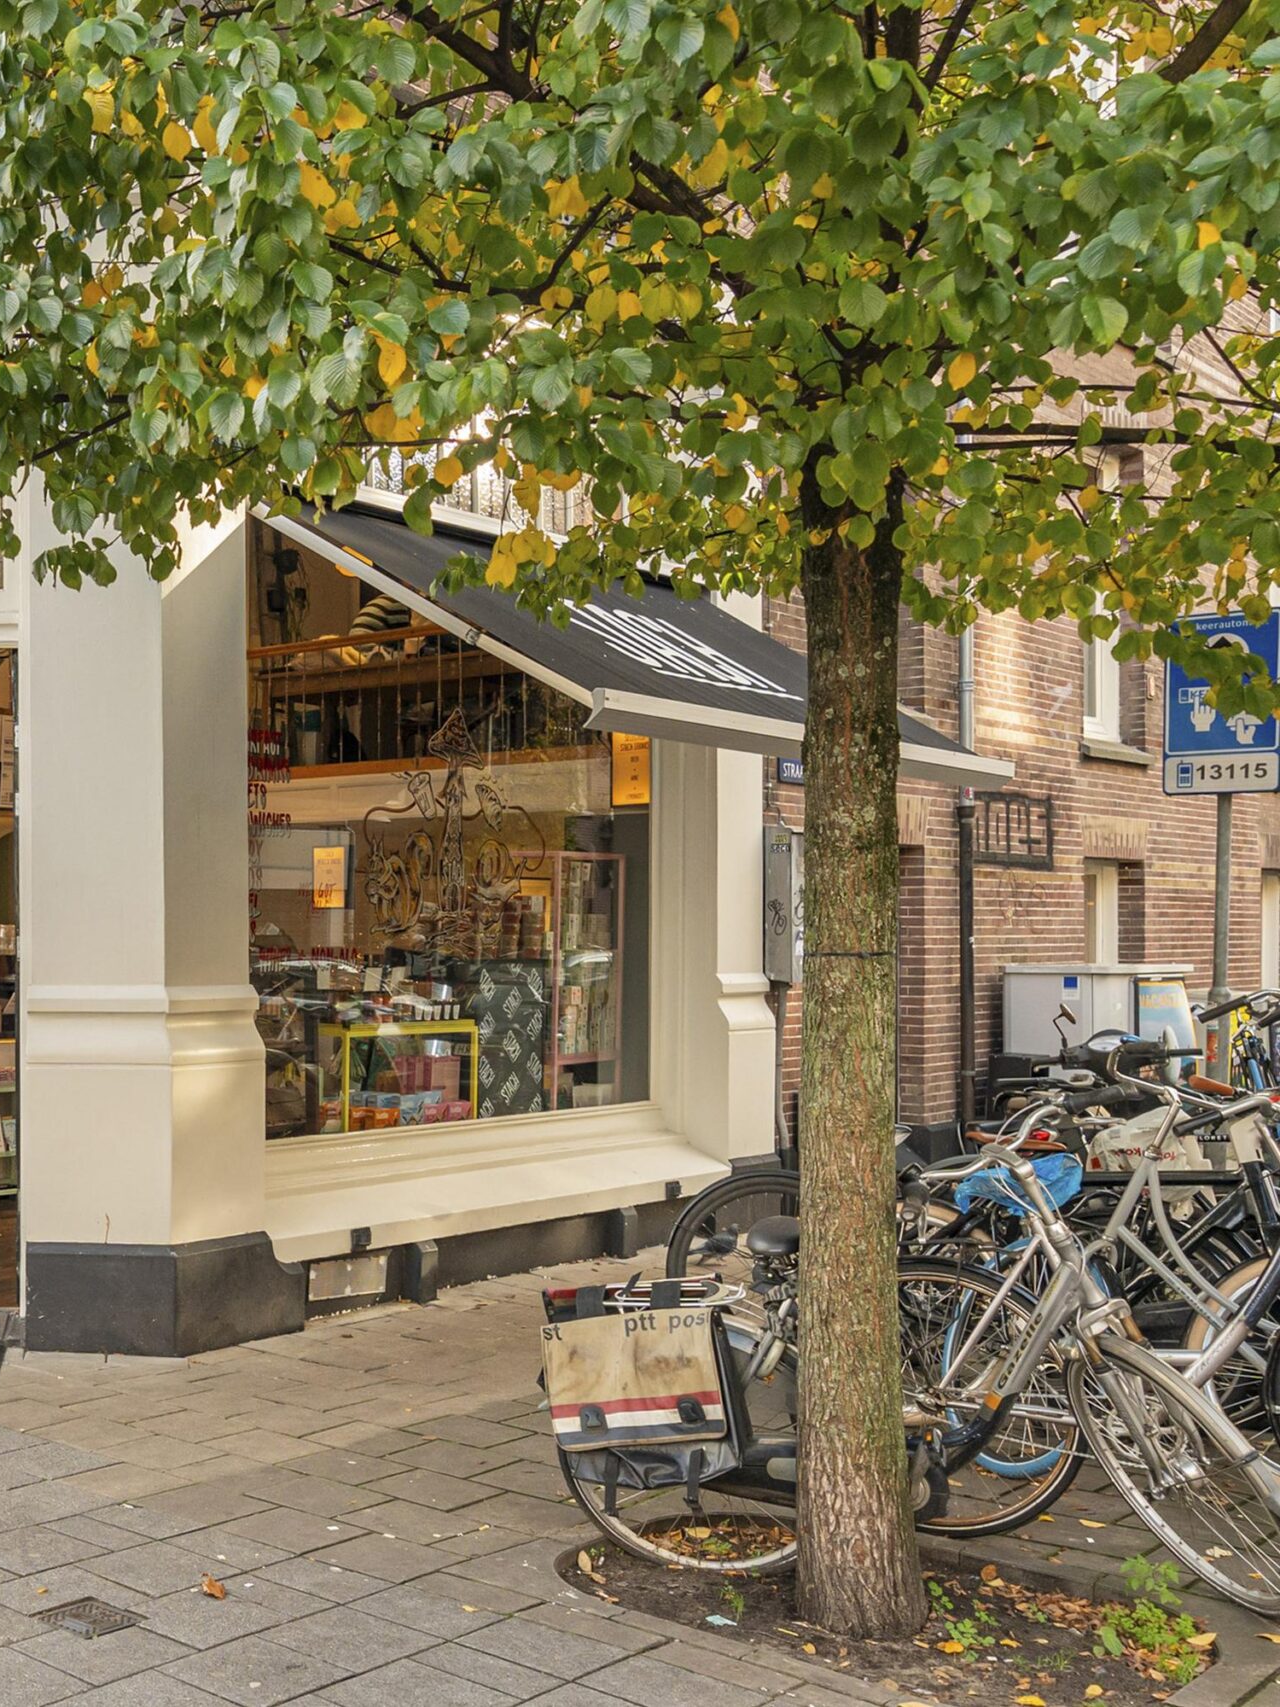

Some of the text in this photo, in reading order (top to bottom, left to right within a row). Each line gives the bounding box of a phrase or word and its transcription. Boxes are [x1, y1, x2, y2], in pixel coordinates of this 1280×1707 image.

[1196, 762, 1268, 781] 13115
[502, 986, 522, 1019] STACH
[500, 1071, 521, 1106] STACH
[624, 1313, 657, 1337] ptt
